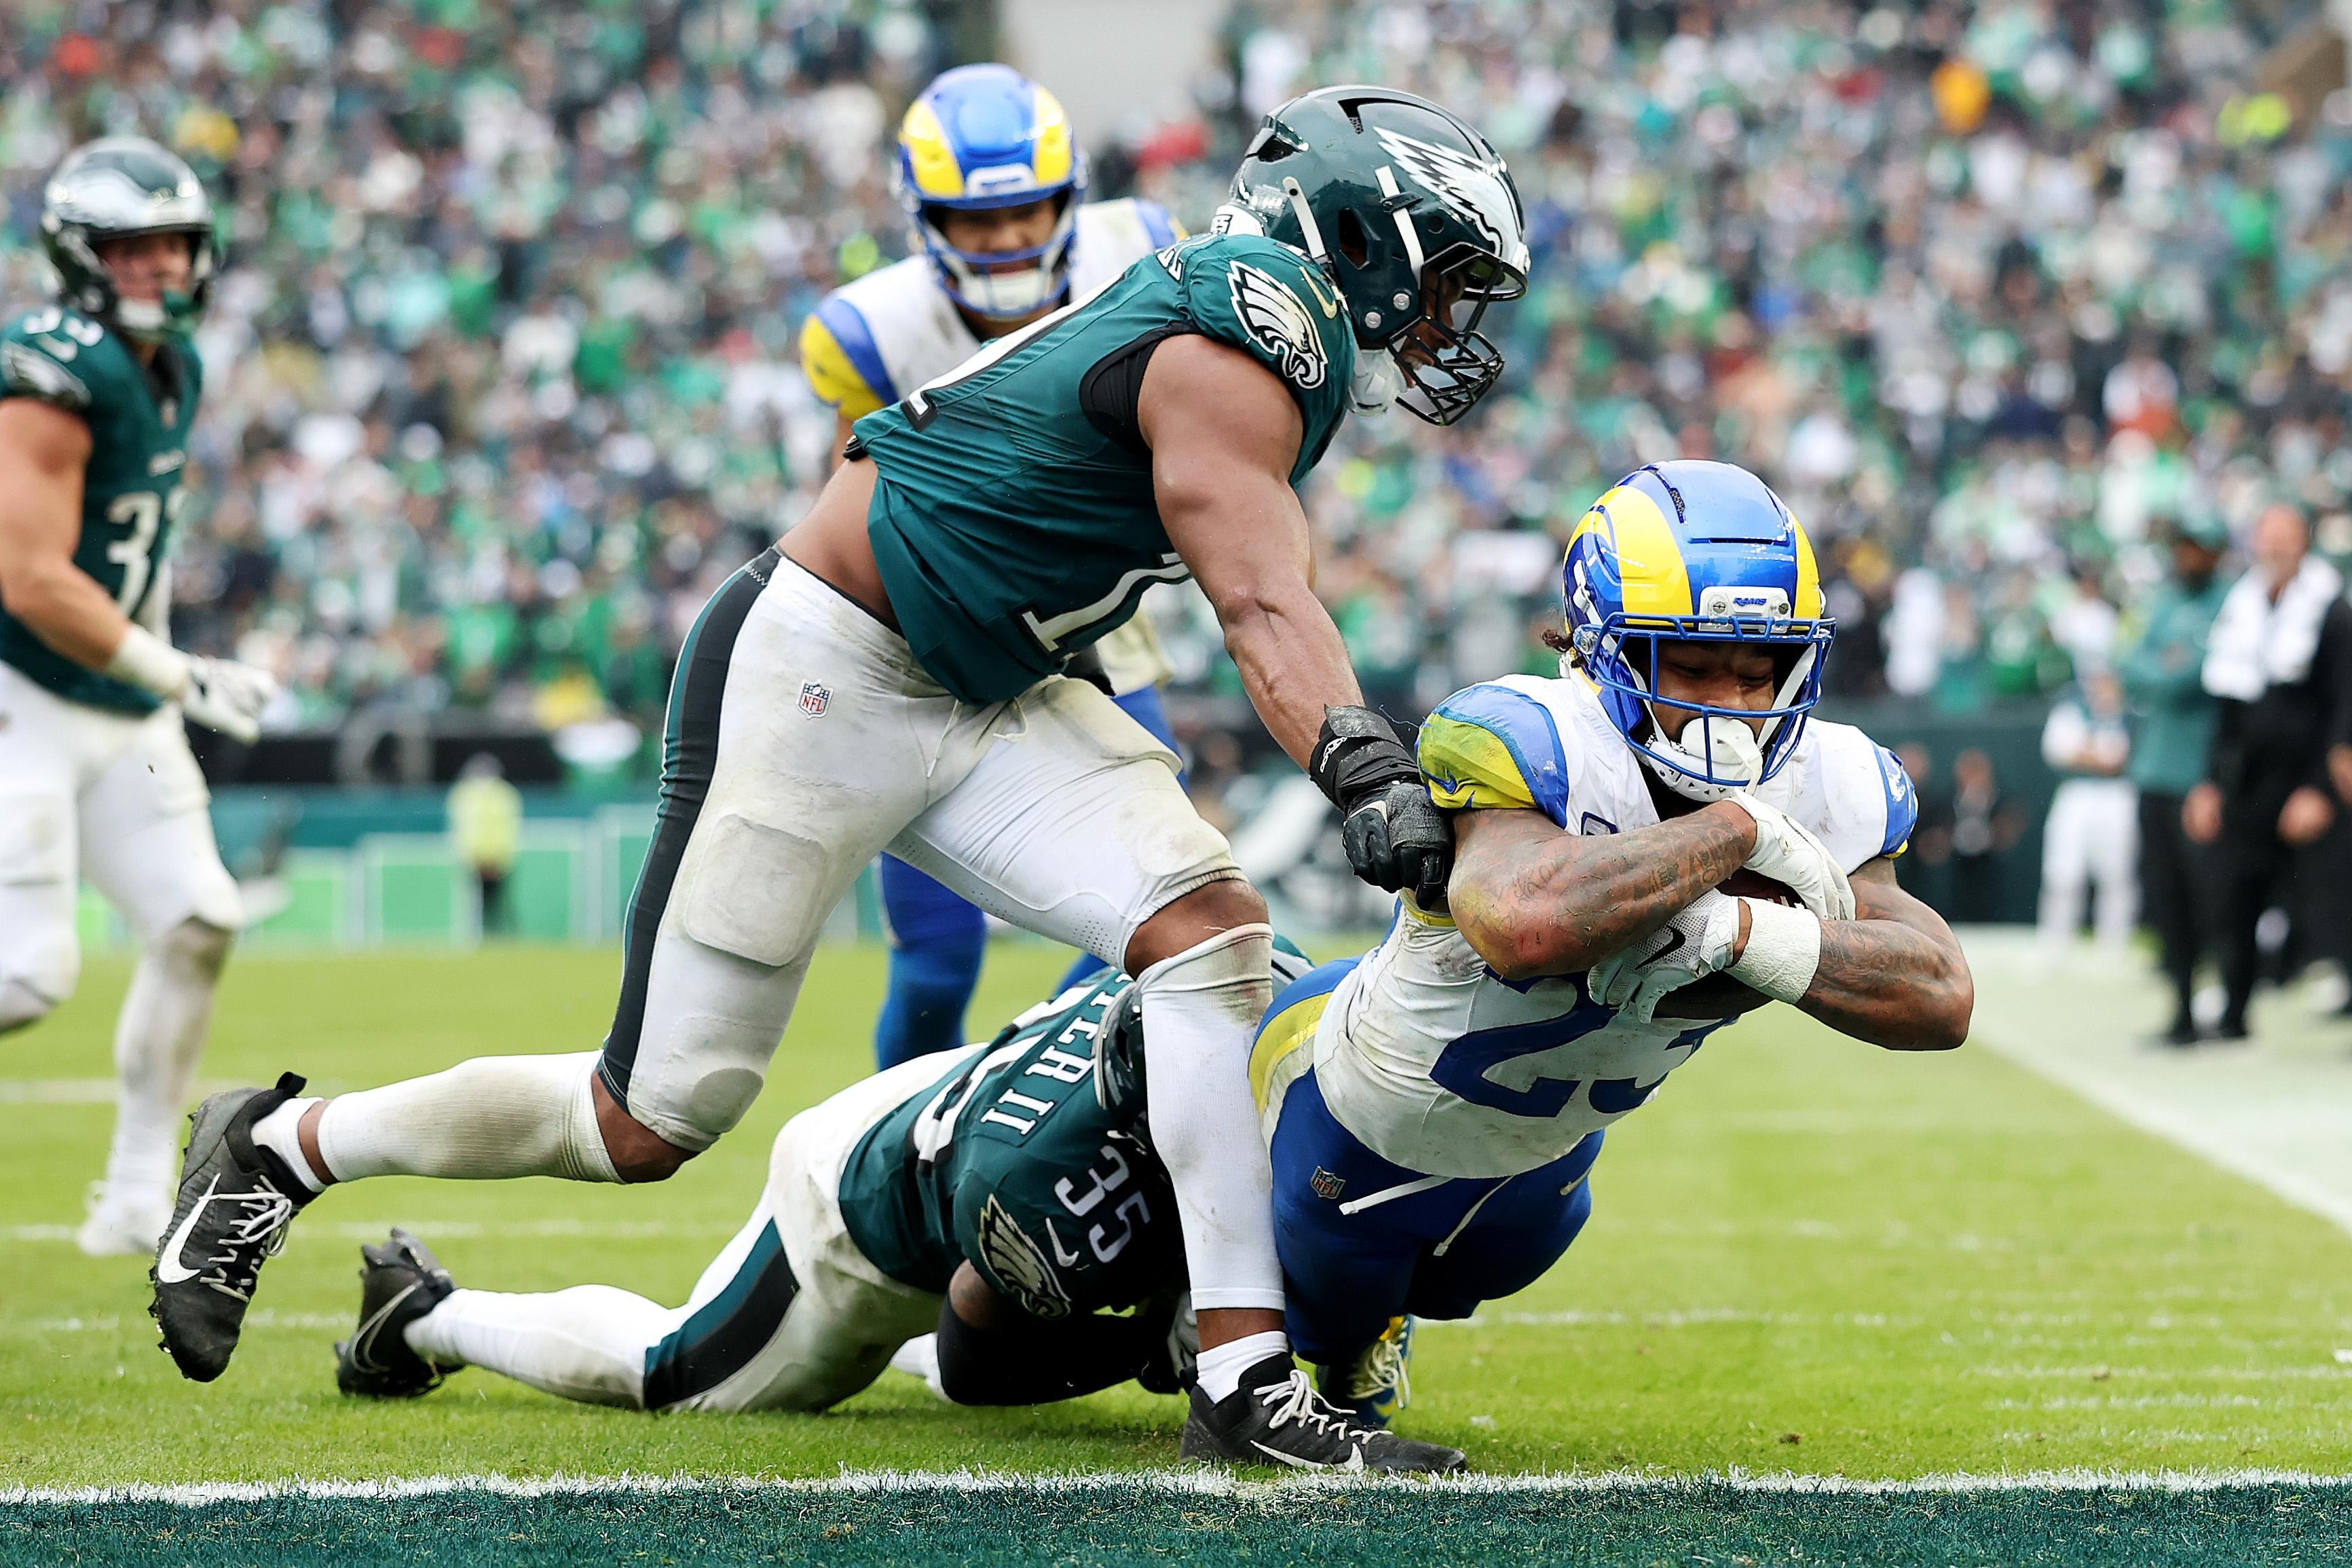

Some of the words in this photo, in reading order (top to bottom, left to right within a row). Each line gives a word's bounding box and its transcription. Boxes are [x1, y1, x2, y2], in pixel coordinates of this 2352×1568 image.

[1732, 597, 1768, 607] RAMS
[802, 694, 823, 712] NFL
[980, 1088, 1055, 1136] II
[1314, 1178, 1335, 1196] NFL
[1054, 1144, 1151, 1263] 35
